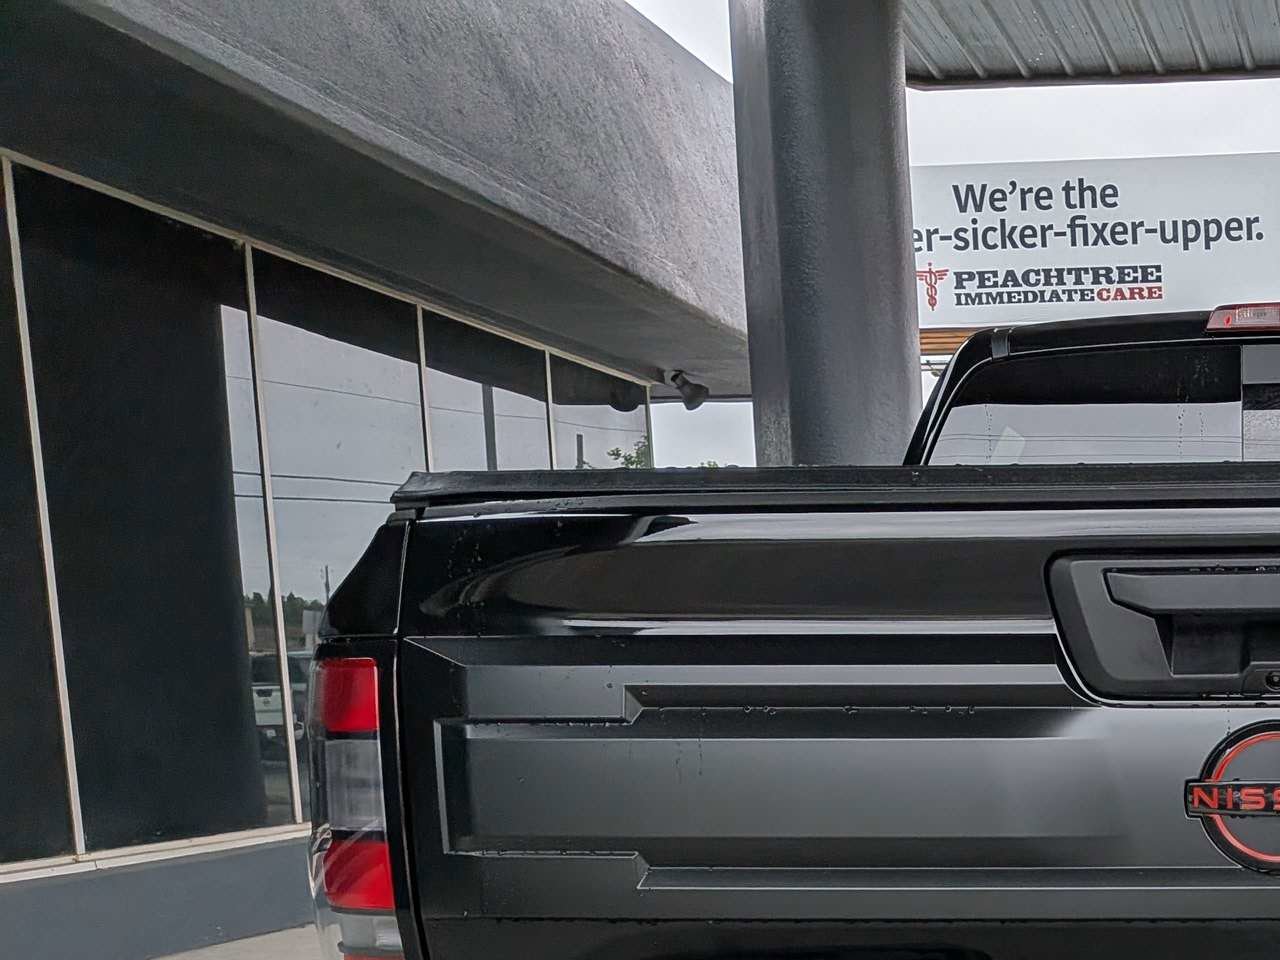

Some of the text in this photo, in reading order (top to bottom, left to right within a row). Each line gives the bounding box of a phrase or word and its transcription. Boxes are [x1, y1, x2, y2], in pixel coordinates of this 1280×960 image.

[952, 177, 1119, 213] We're the
[953, 264, 1163, 290] PEACHTREE
